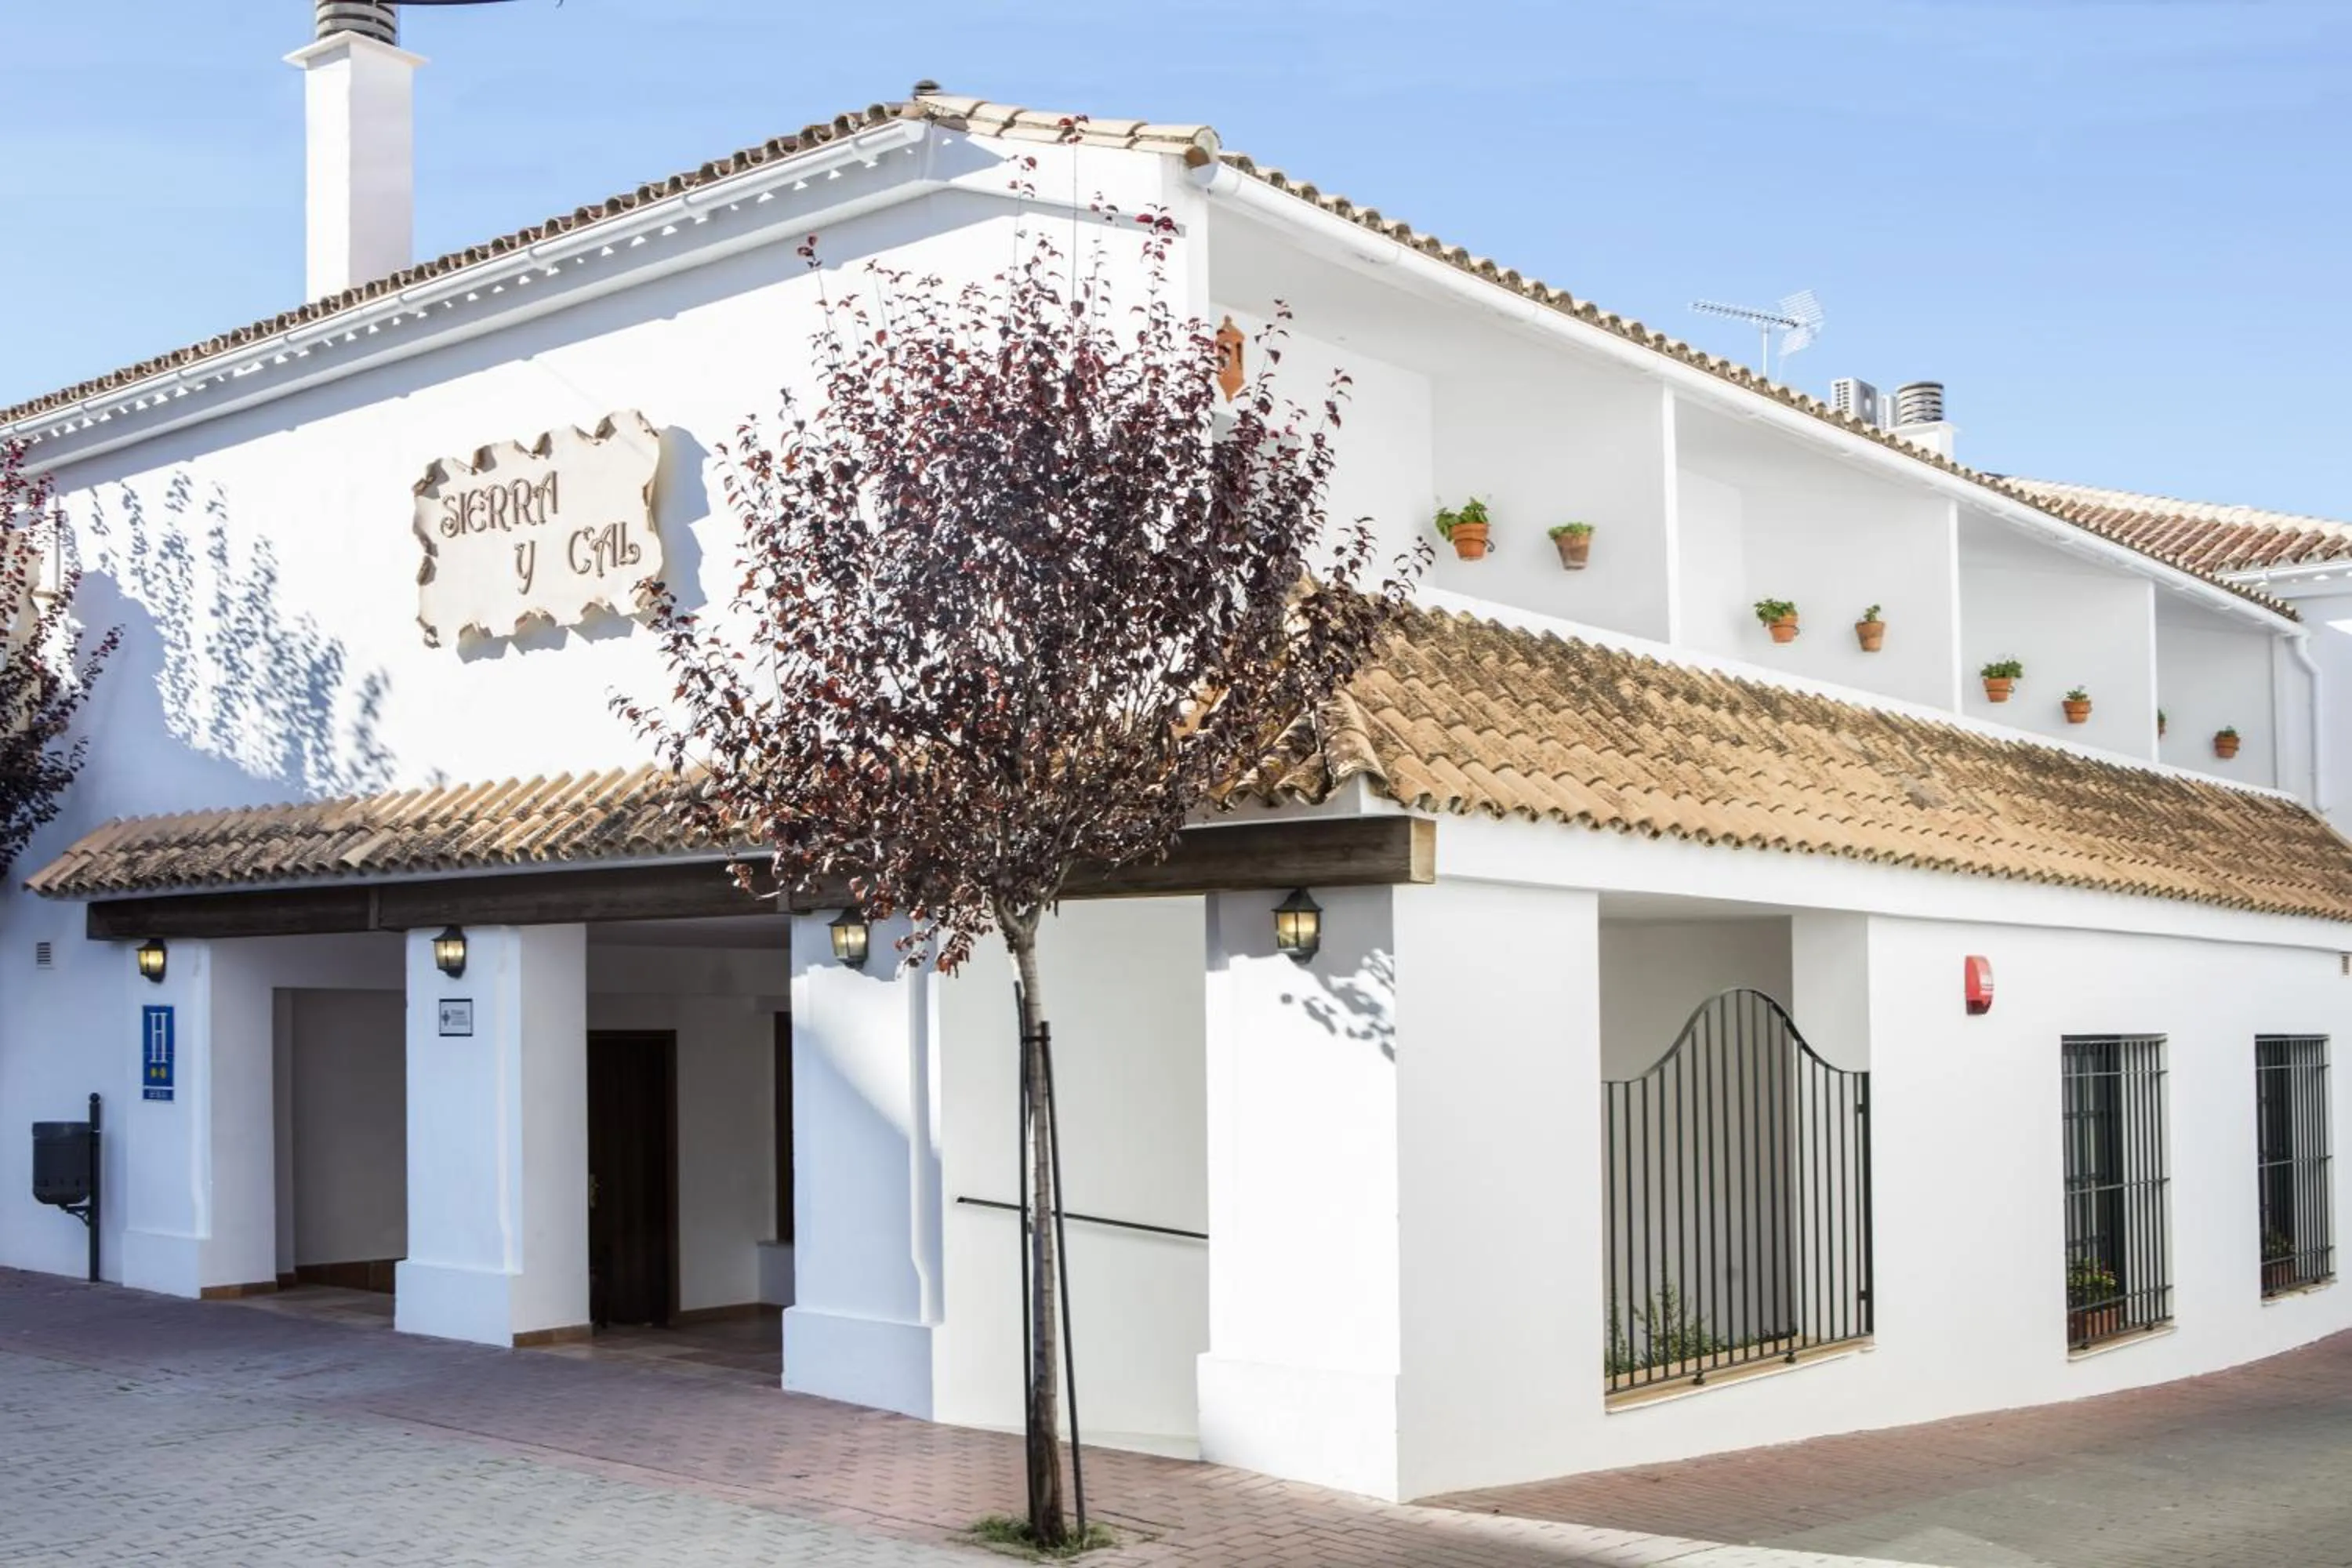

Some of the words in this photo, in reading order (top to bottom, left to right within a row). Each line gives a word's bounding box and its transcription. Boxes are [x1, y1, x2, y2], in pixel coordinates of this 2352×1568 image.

[440, 470, 558, 539] SIERRA
[568, 521, 641, 578] CAL
[149, 1012, 168, 1063] H
